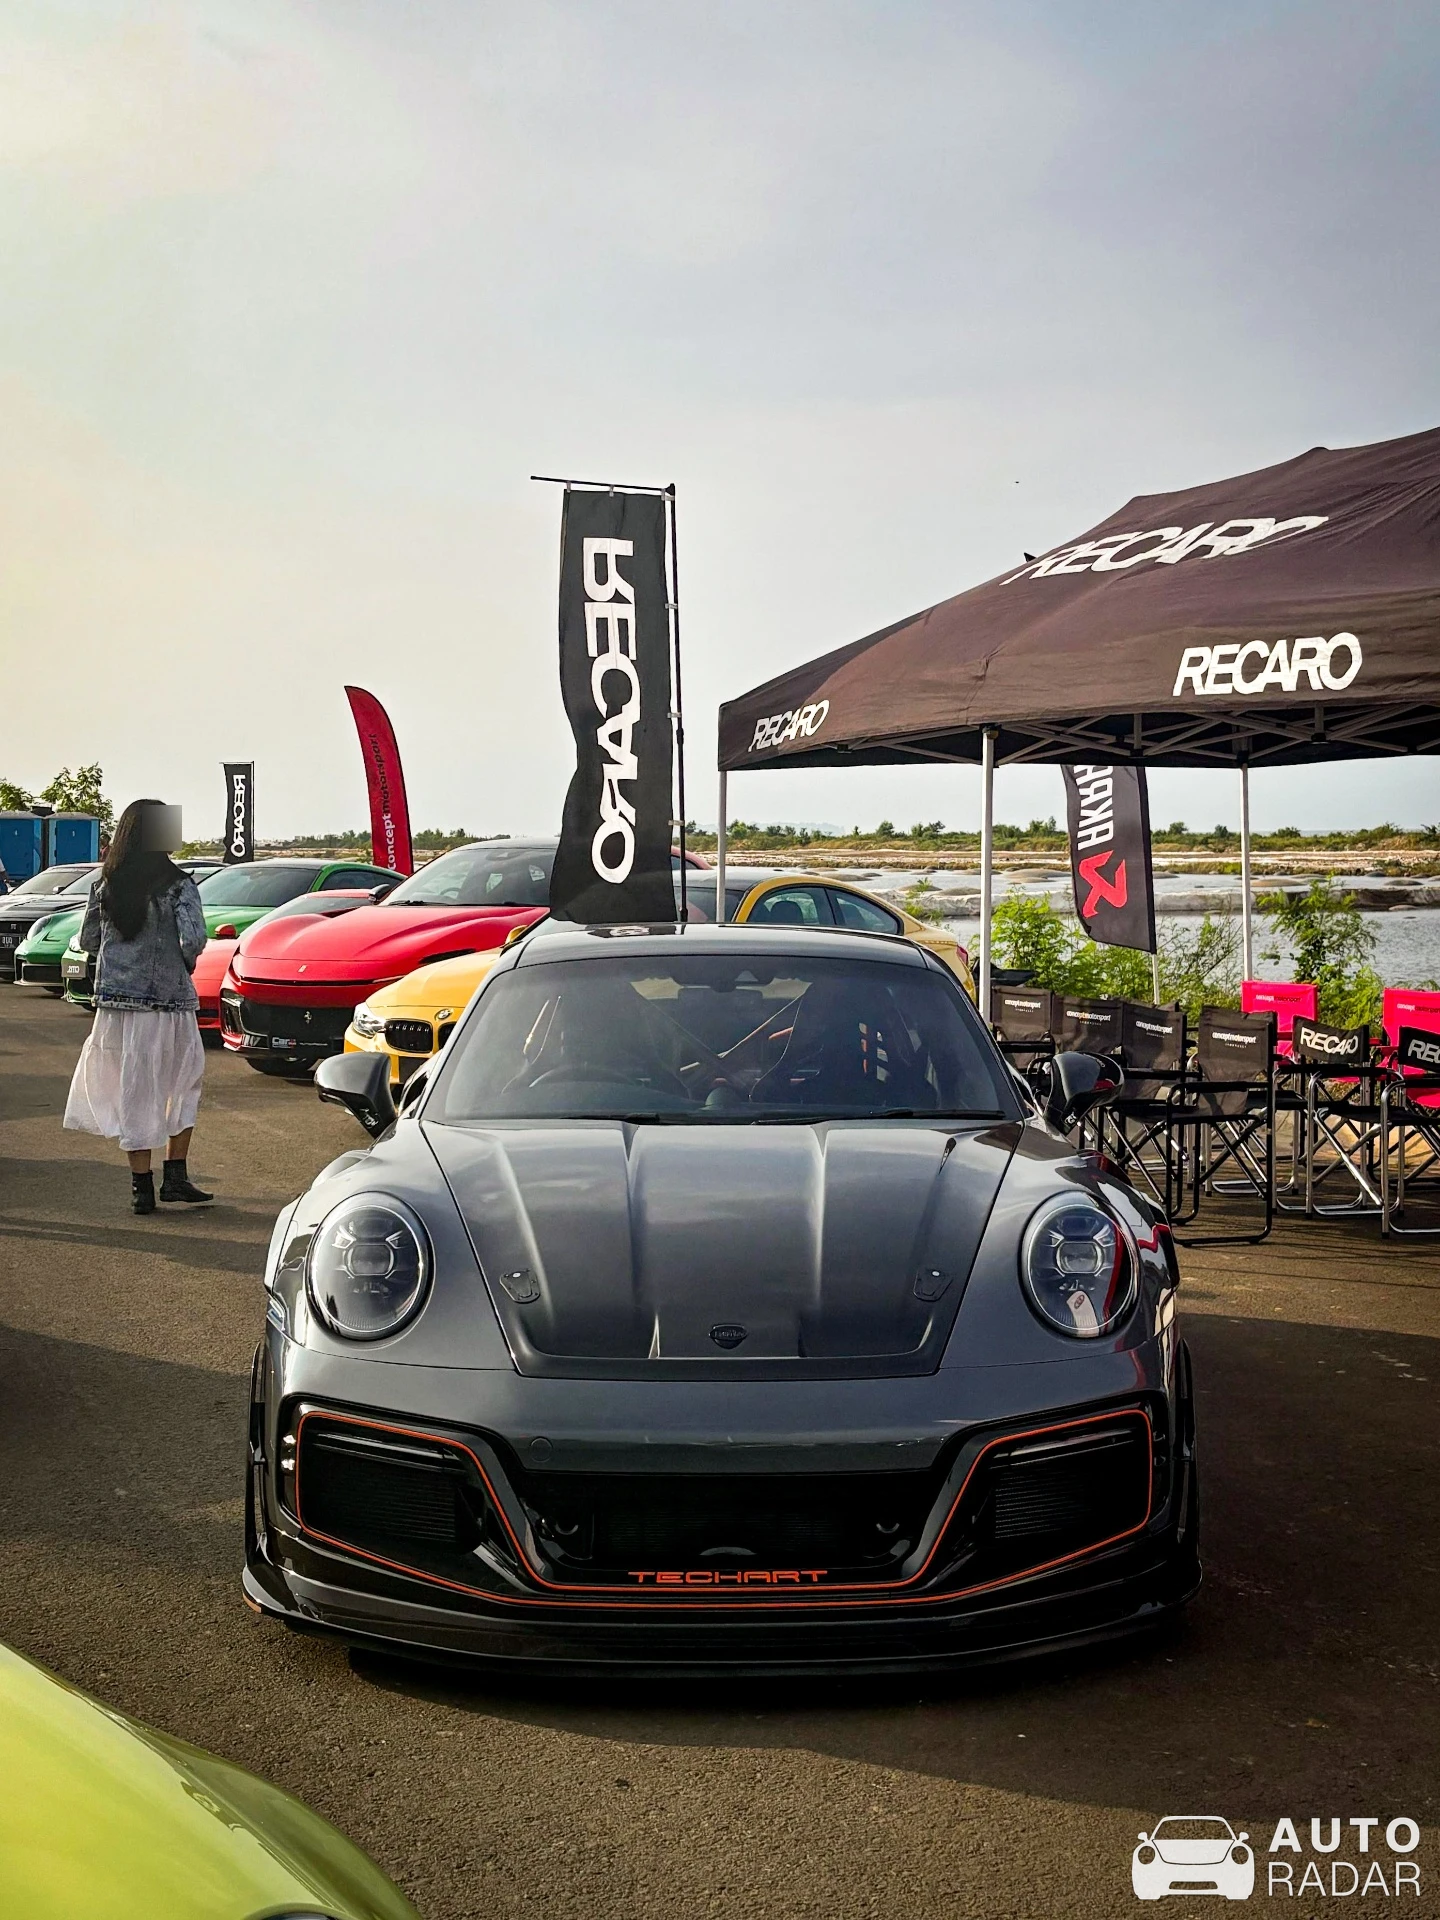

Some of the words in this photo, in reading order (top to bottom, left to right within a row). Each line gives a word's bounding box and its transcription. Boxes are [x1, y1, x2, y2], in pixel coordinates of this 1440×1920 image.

[1000, 515, 1330, 586] RECARO
[1172, 632, 1363, 696] RECARO
[747, 700, 830, 752] RECARO
[628, 1570, 828, 1583] TECHART
